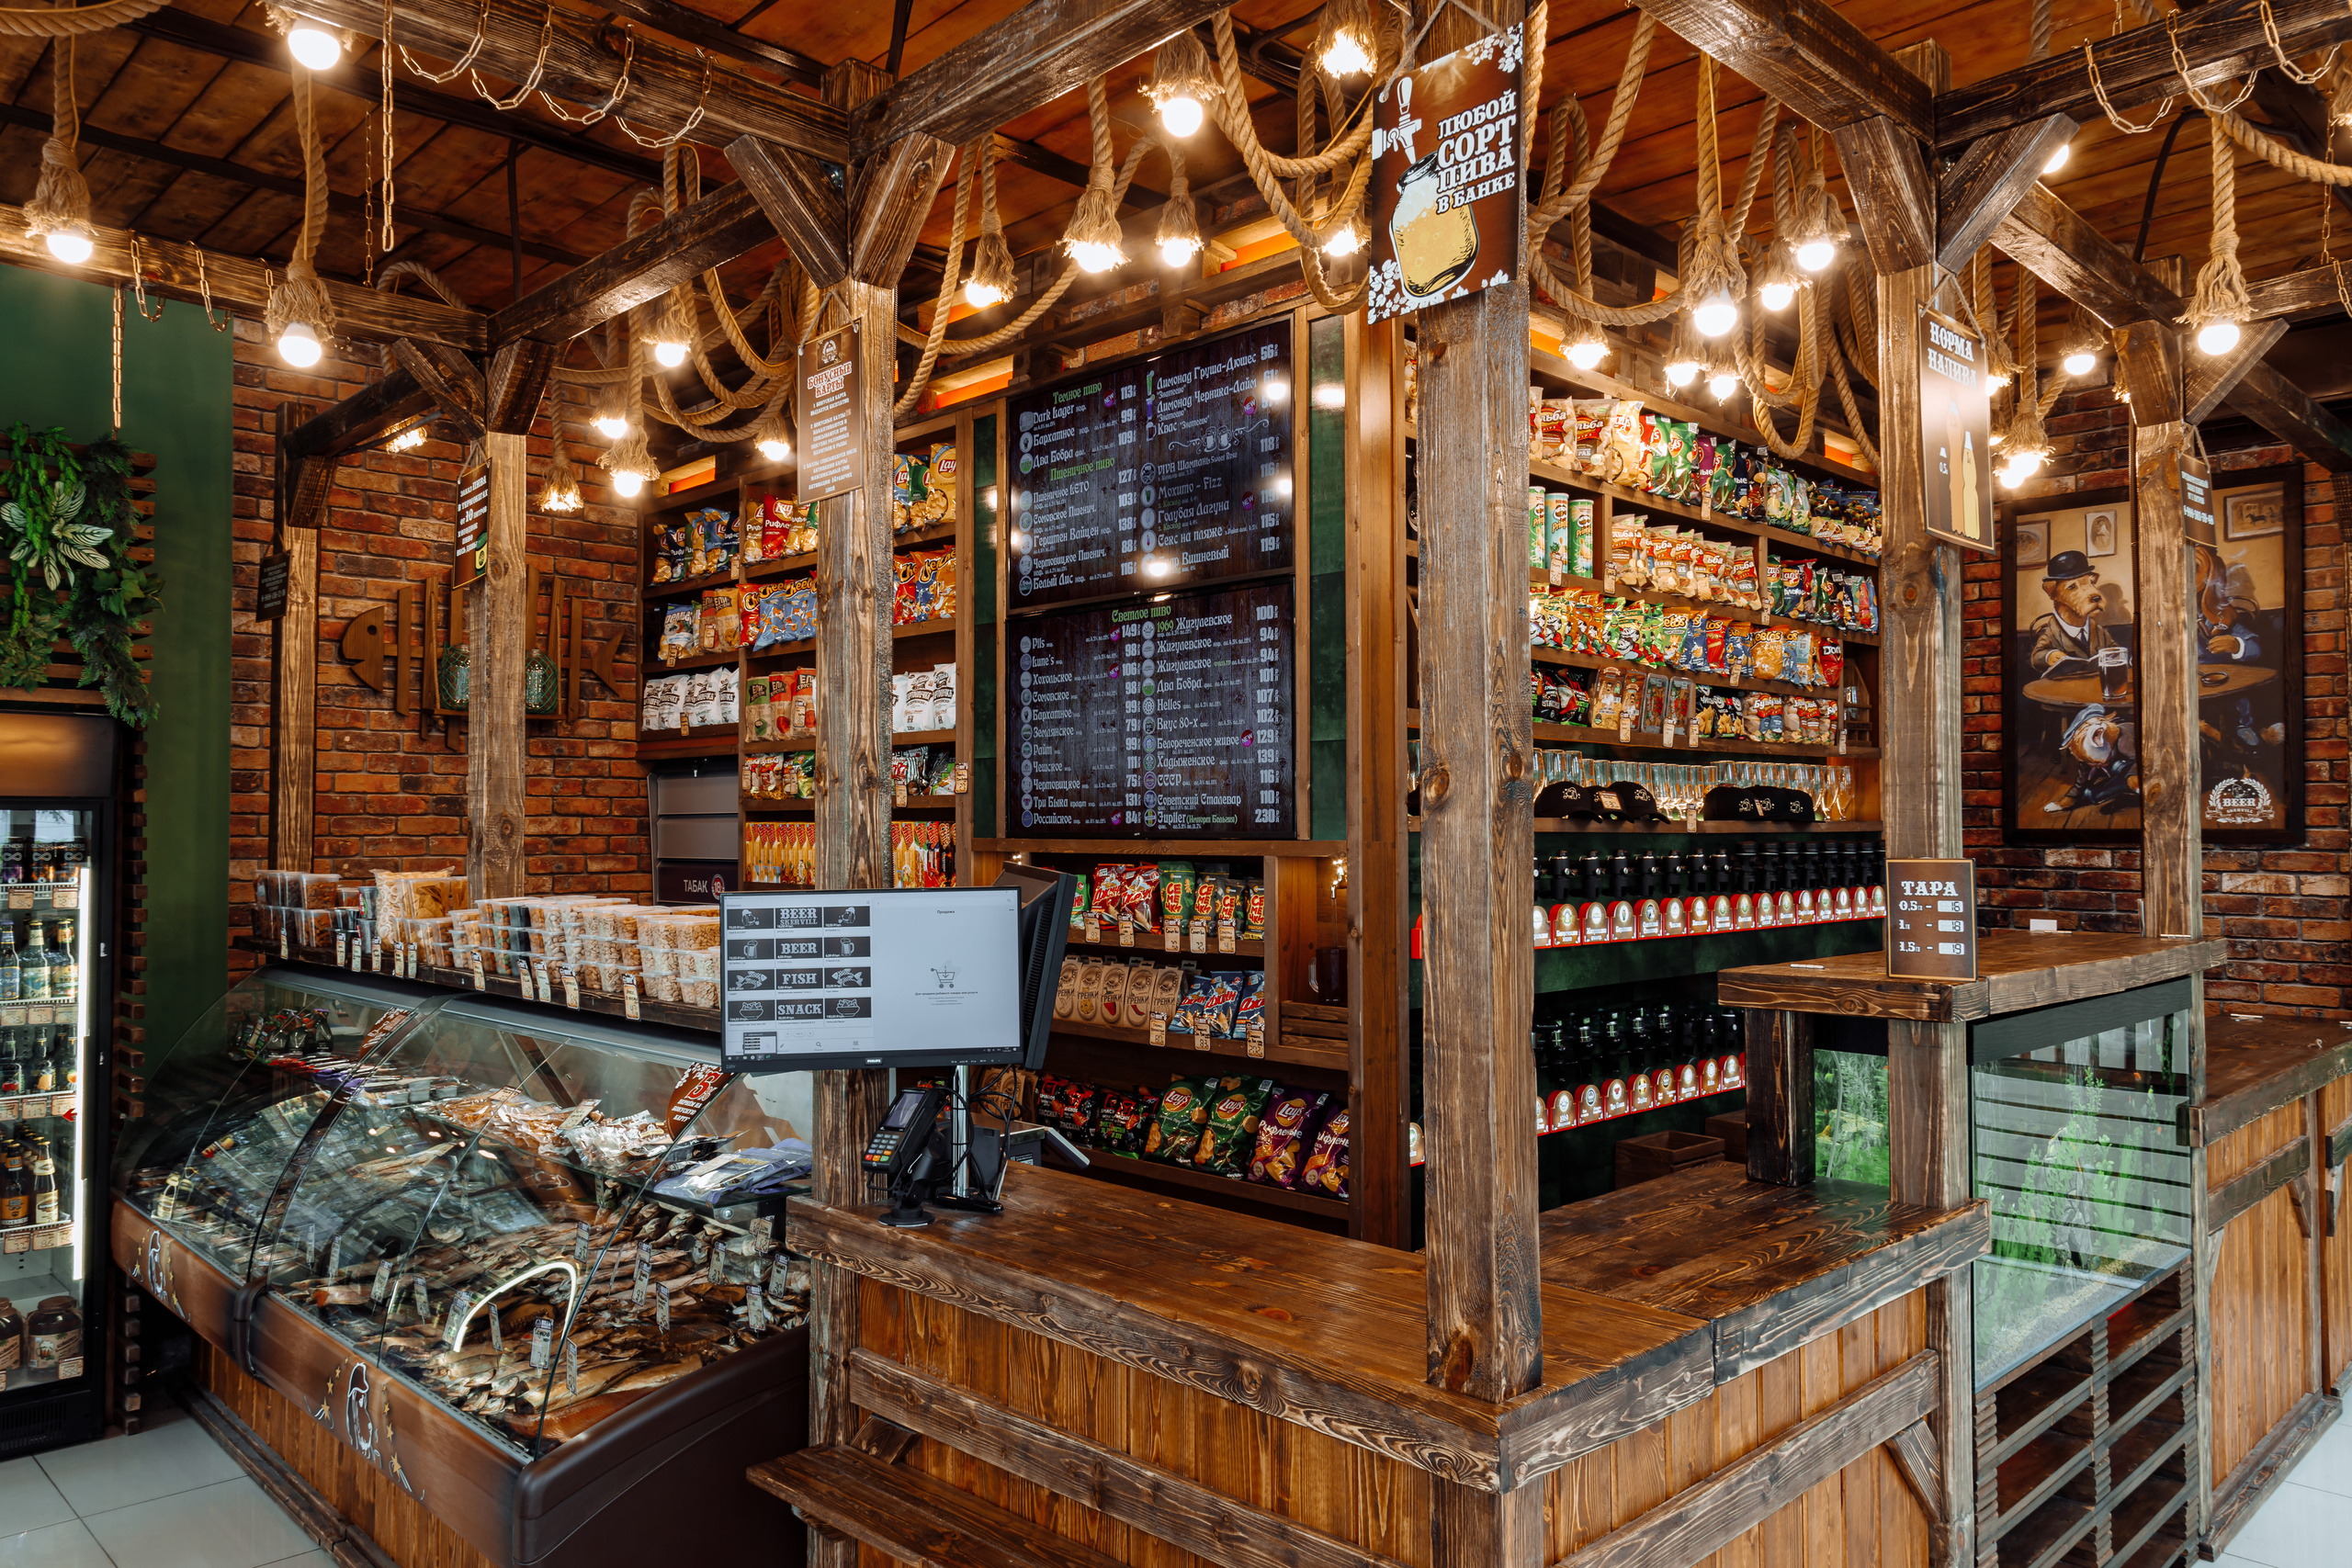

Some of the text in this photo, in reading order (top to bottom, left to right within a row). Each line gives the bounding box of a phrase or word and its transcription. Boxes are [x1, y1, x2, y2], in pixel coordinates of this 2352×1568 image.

[1438, 89, 1516, 140] ЛЮБОЙ
[1438, 114, 1516, 169] СОРТ
[1437, 145, 1515, 193] ПИВА
[1437, 172, 1515, 214] В БАНКЕ
[1930, 321, 1974, 362] НОРМА
[808, 361, 852, 389] БОНУСНЫЕ
[1157, 344, 1274, 390] Лимонад Груша-Дюшес 56
[1928, 347, 1977, 389] НАЛИВА
[816, 376, 844, 398] КАРТЫ
[1053, 382, 1102, 404] Темное пиво
[1121, 385, 1133, 400] 113
[1157, 396, 1193, 413] Лимонад
[1194, 378, 1257, 403] Черника-Лайм
[1034, 404, 1074, 423] Dark Lager
[1244, 399, 1256, 412] NEW
[1121, 409, 1132, 423] 99
[1034, 427, 1132, 446] Бархатное 109
[1158, 422, 1177, 435] Квас
[1261, 436, 1274, 453] 118
[1033, 448, 1073, 469] Два Бобра
[1050, 457, 1114, 481] Пшеничное пиво
[1034, 488, 1069, 502] Пшеничное
[1118, 468, 1133, 484] 127
[1158, 483, 1194, 500] Мохито
[1034, 510, 1067, 525] Сомовское
[1118, 492, 1133, 507] 103
[1242, 494, 1254, 506] NEW
[1158, 507, 1193, 524] Голубая
[1196, 500, 1229, 516] Лагуна
[1261, 513, 1275, 529] 115
[1118, 516, 1133, 532] 138
[1034, 533, 1068, 547] Герштен
[1070, 525, 1099, 540] Вайцен
[1158, 534, 1178, 547] Секс
[1181, 534, 1191, 543] на
[1193, 527, 1223, 540] пляже
[1034, 553, 1077, 570] Чертовицкое
[1122, 539, 1133, 554] 88
[1182, 545, 1228, 565] Вишневый
[1261, 536, 1275, 552] 119
[1034, 576, 1057, 590] Белый
[1058, 573, 1073, 585] Лис
[1112, 605, 1171, 623] Светлое пиво
[1157, 620, 1174, 633] 1969
[1176, 614, 1232, 630] Жигулевское
[1256, 605, 1273, 621] 100
[1122, 624, 1136, 638] 149
[1157, 637, 1212, 654] Жигулевское
[1260, 626, 1274, 642] 94
[1125, 643, 1136, 657] 98
[1123, 662, 1136, 676] 106
[1157, 658, 1212, 673] Жигулевское
[1260, 648, 1274, 662] 94
[1125, 682, 1136, 695] 98
[1157, 668, 1274, 694] Два Бобра 101
[1157, 689, 1274, 711] Helles 107
[1033, 700, 1136, 722] Бархатное 99
[1158, 717, 1177, 732] Вкус
[1257, 708, 1274, 723] 102
[1033, 718, 1136, 738] Землянское 79
[1257, 729, 1274, 744] 129
[1125, 738, 1136, 750] 99
[1157, 736, 1239, 750] Белореченское живое
[1241, 733, 1253, 744] NEW
[1034, 761, 1063, 773] Чешское
[1157, 749, 1274, 769] Хадыженское 139
[1034, 774, 1137, 792] Чертовицкое 75
[1260, 769, 1274, 784] 116
[1034, 796, 1046, 809] Три
[1048, 796, 1068, 807] Быка
[1125, 793, 1137, 806] 131
[1158, 790, 1275, 807] Советский Сталевар 110
[2222, 798, 2256, 807] BEER
[1034, 812, 1071, 824] Российское
[1125, 811, 1137, 824] 84
[1255, 808, 1275, 823] 230
[684, 879, 708, 893] ТАБАК
[1901, 881, 1958, 896] ТАРА
[780, 908, 818, 919] BEER
[781, 942, 818, 954] BEER
[783, 973, 817, 985] FISH
[778, 1003, 822, 1015] SNACK
